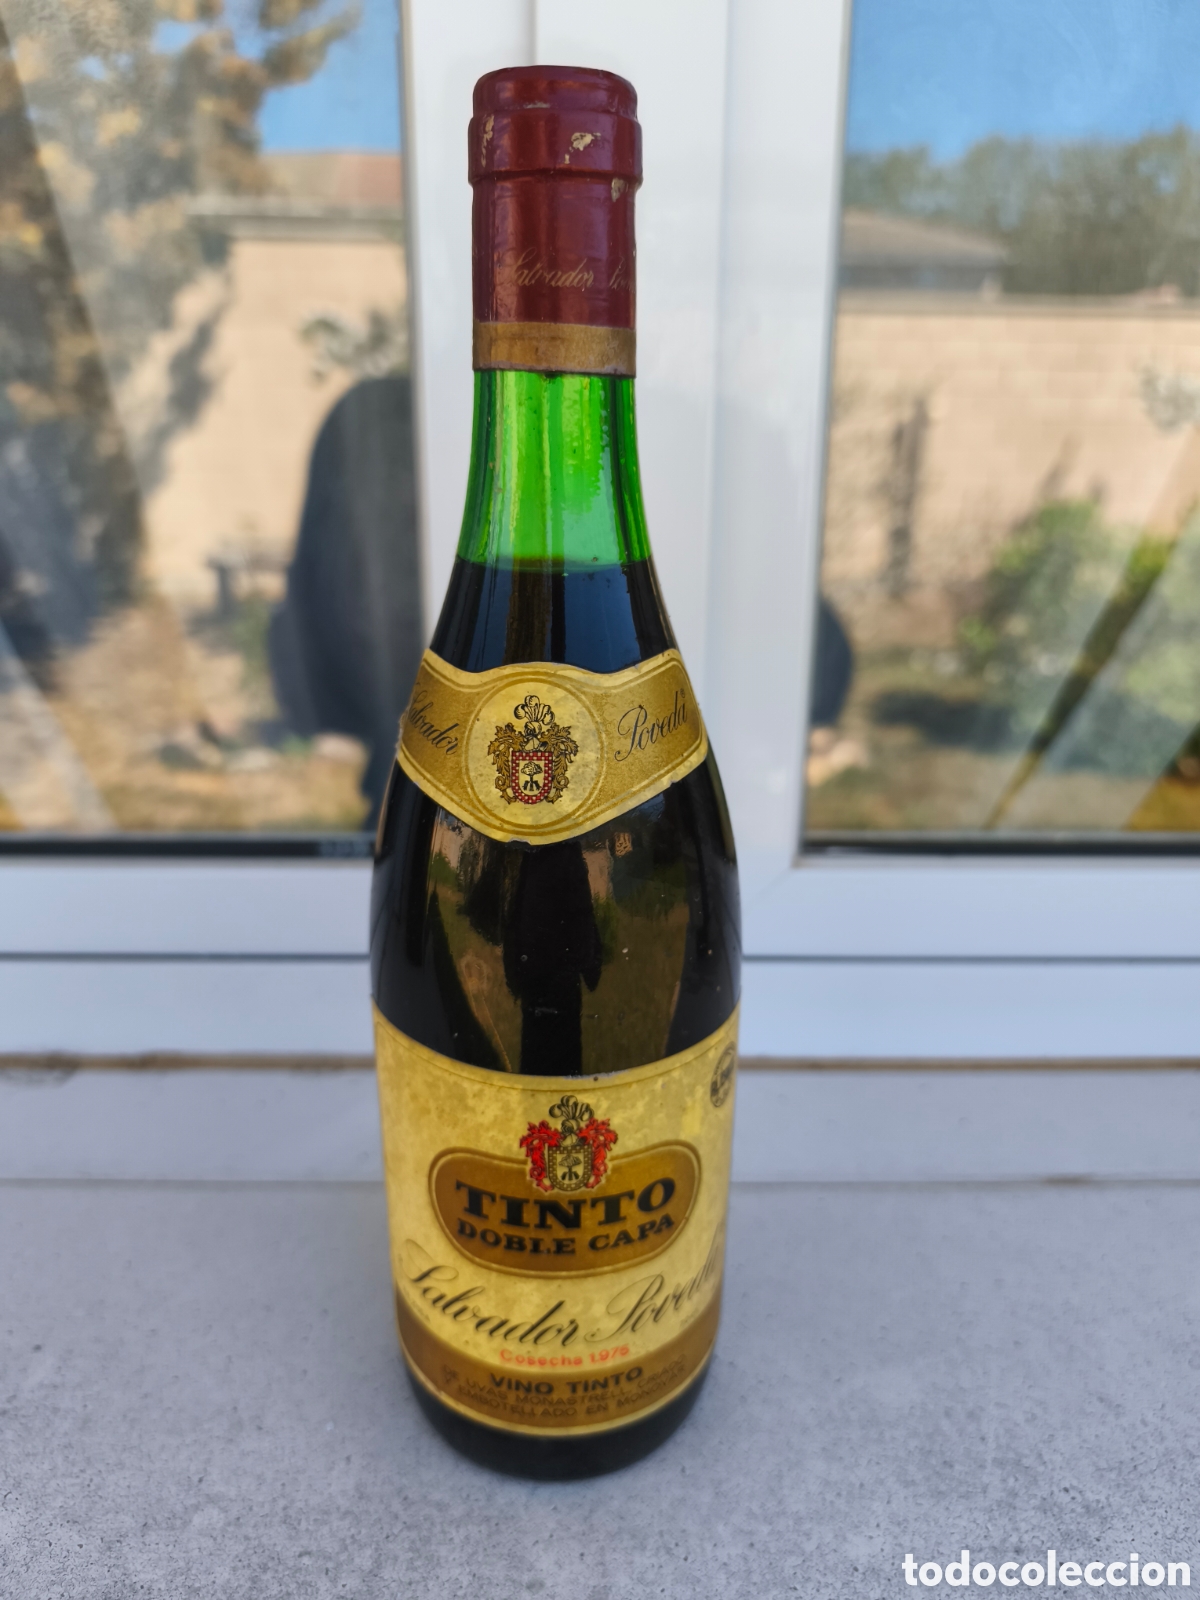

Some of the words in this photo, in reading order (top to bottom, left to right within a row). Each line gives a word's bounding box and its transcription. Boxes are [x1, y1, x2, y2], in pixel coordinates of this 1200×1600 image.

[614, 690, 688, 762] Poveda
[455, 1177, 677, 1230] TINTO
[458, 1217, 576, 1256] DOBLE
[589, 1213, 675, 1251] CAPA
[397, 1238, 579, 1347] Salvador
[490, 1372, 554, 1395] VINO
[566, 1366, 643, 1395] TINTO
[499, 1348, 583, 1366] Cosecha
